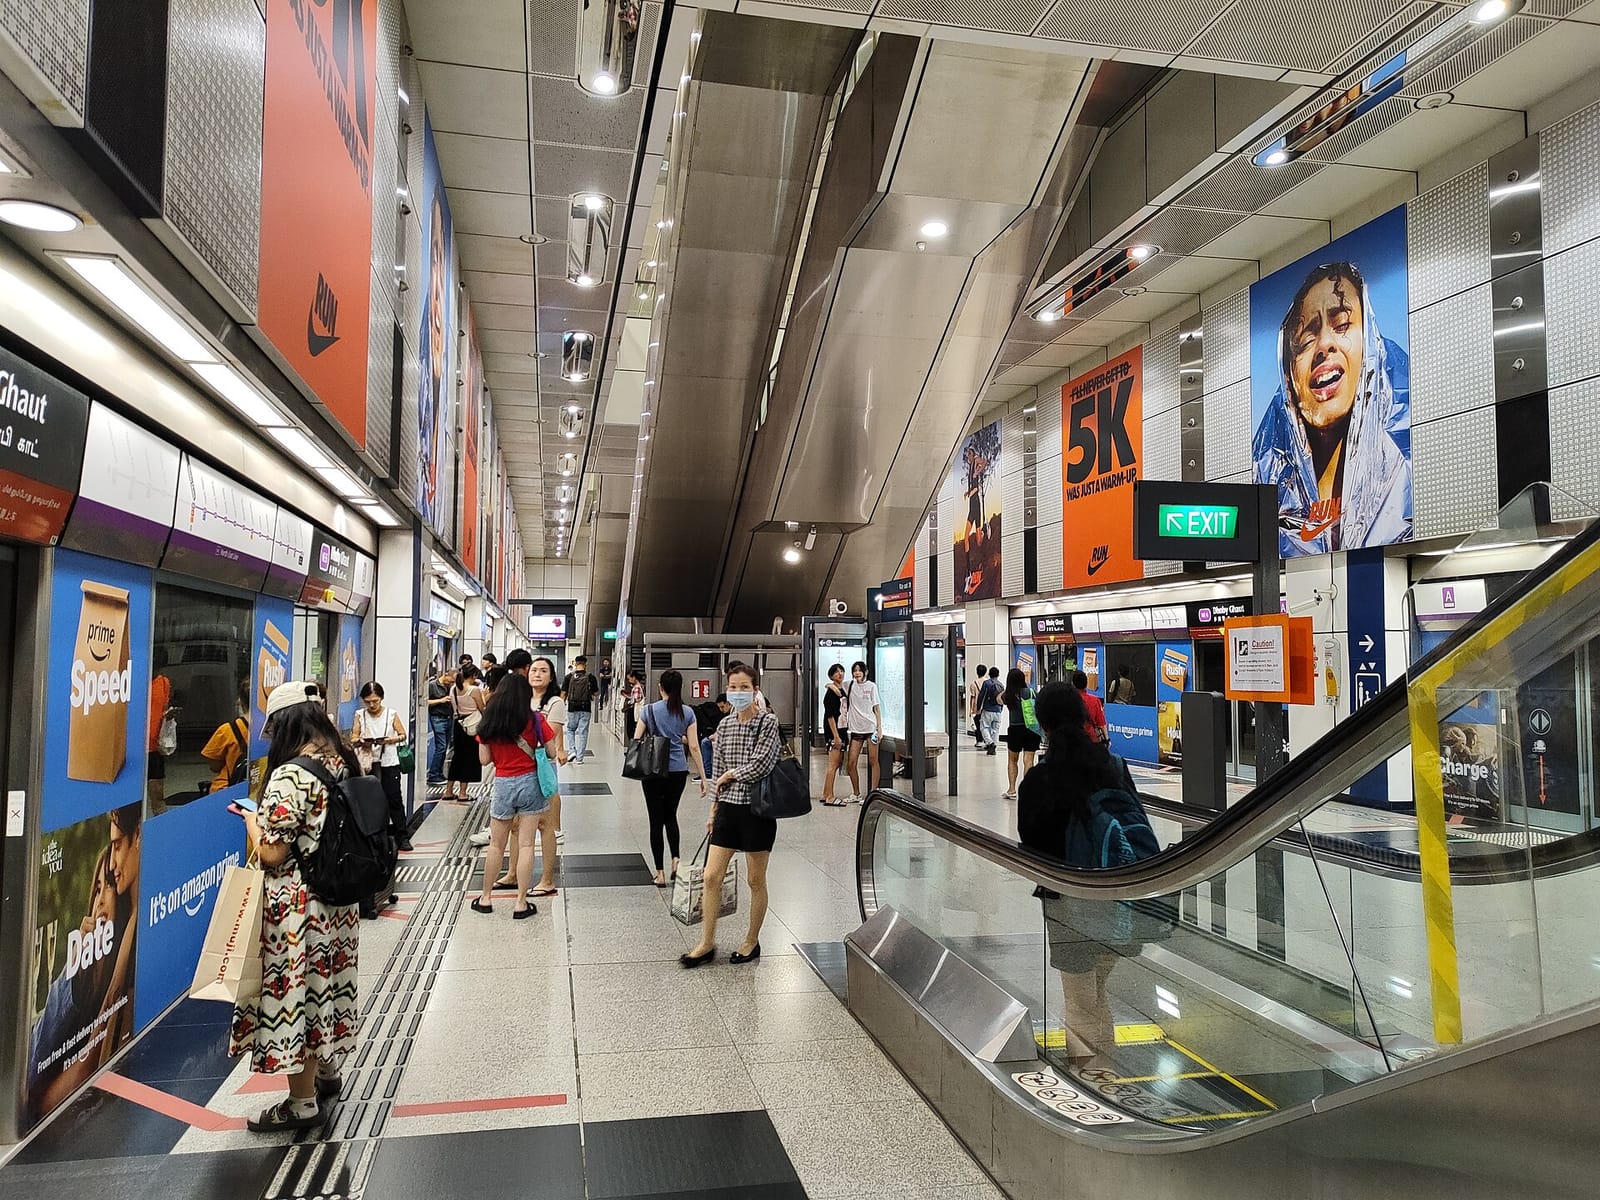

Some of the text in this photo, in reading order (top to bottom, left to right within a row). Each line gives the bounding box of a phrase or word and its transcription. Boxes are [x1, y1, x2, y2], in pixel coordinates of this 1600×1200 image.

[1066, 375, 1137, 485] 5K
[1066, 485, 1080, 502] WAS
[1081, 480, 1095, 498] JUST
[1308, 496, 1342, 523] RUN
[1187, 511, 1230, 535] EXIT
[1091, 544, 1109, 563] RUN
[1445, 590, 1453, 602] A
[87, 620, 115, 645] prime
[69, 659, 132, 715] Speed
[1440, 755, 1489, 781] Charge
[41, 846, 58, 866] idea
[48, 859, 63, 879] you
[150, 892, 167, 928] It's
[167, 887, 181, 915] on
[181, 868, 216, 906] amazon
[66, 916, 115, 980] Date
[37, 1055, 52, 1074] From
[51, 1047, 62, 1063] free
[66, 1035, 77, 1051] fast
